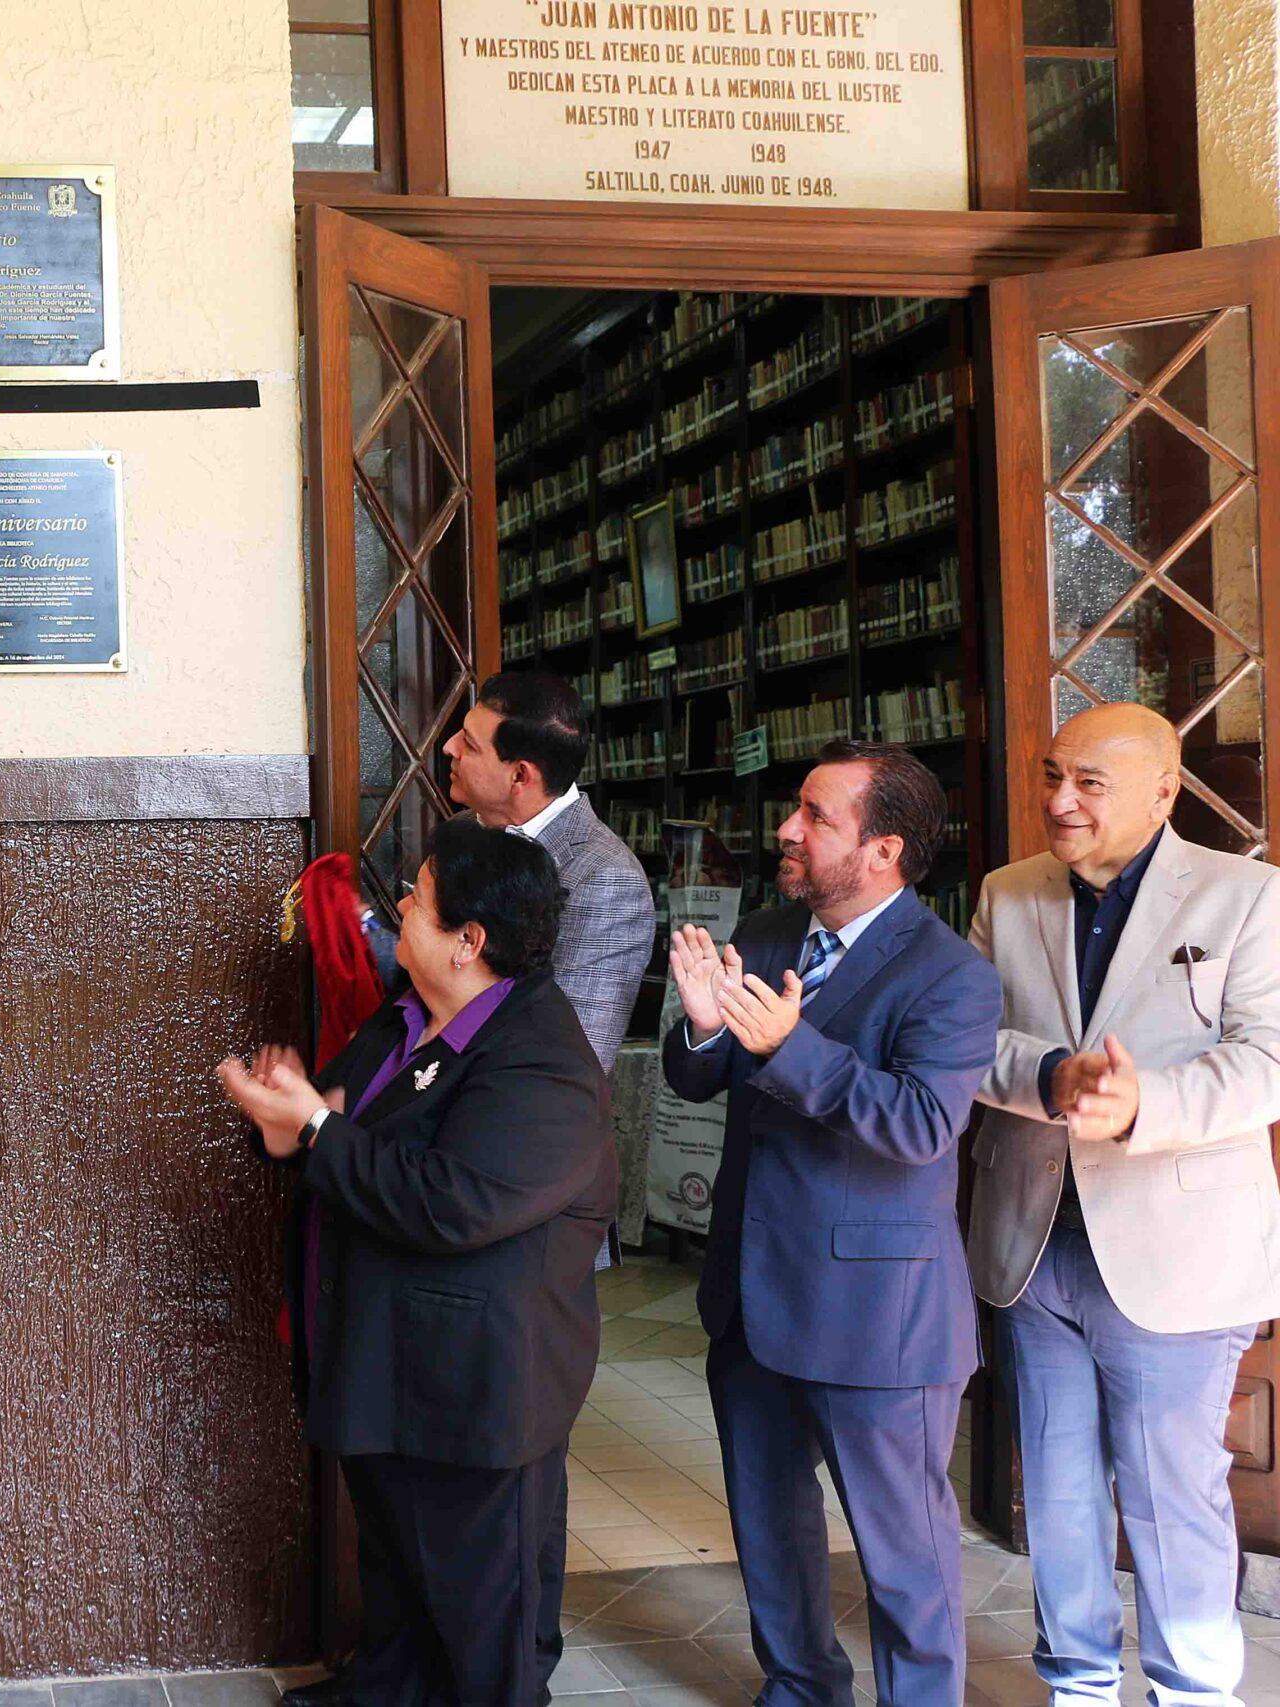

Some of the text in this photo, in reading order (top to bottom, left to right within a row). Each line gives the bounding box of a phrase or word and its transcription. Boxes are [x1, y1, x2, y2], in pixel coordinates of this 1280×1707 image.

[608, 4, 698, 32] ANTONIO
[708, 7, 735, 34] DE
[744, 8, 772, 35] LA
[460, 37, 944, 73] Y MAESTROS DEL ATENEO DE ACUERDO CON EL GBNO. DEL EDO.
[508, 71, 902, 104] DEDICAN ESTA PLACA A LA MEMORIA DEL ILUSTRE
[565, 105, 851, 134] MAESTRO Y LITERATO COAHUILENSE.
[635, 140, 786, 163] 1947 1948
[586, 171, 837, 199] SALTILLO, COAH. JUNIO DE 1948.
[11, 203, 41, 212] Fuente
[20, 553, 89, 571] Rodríguez
